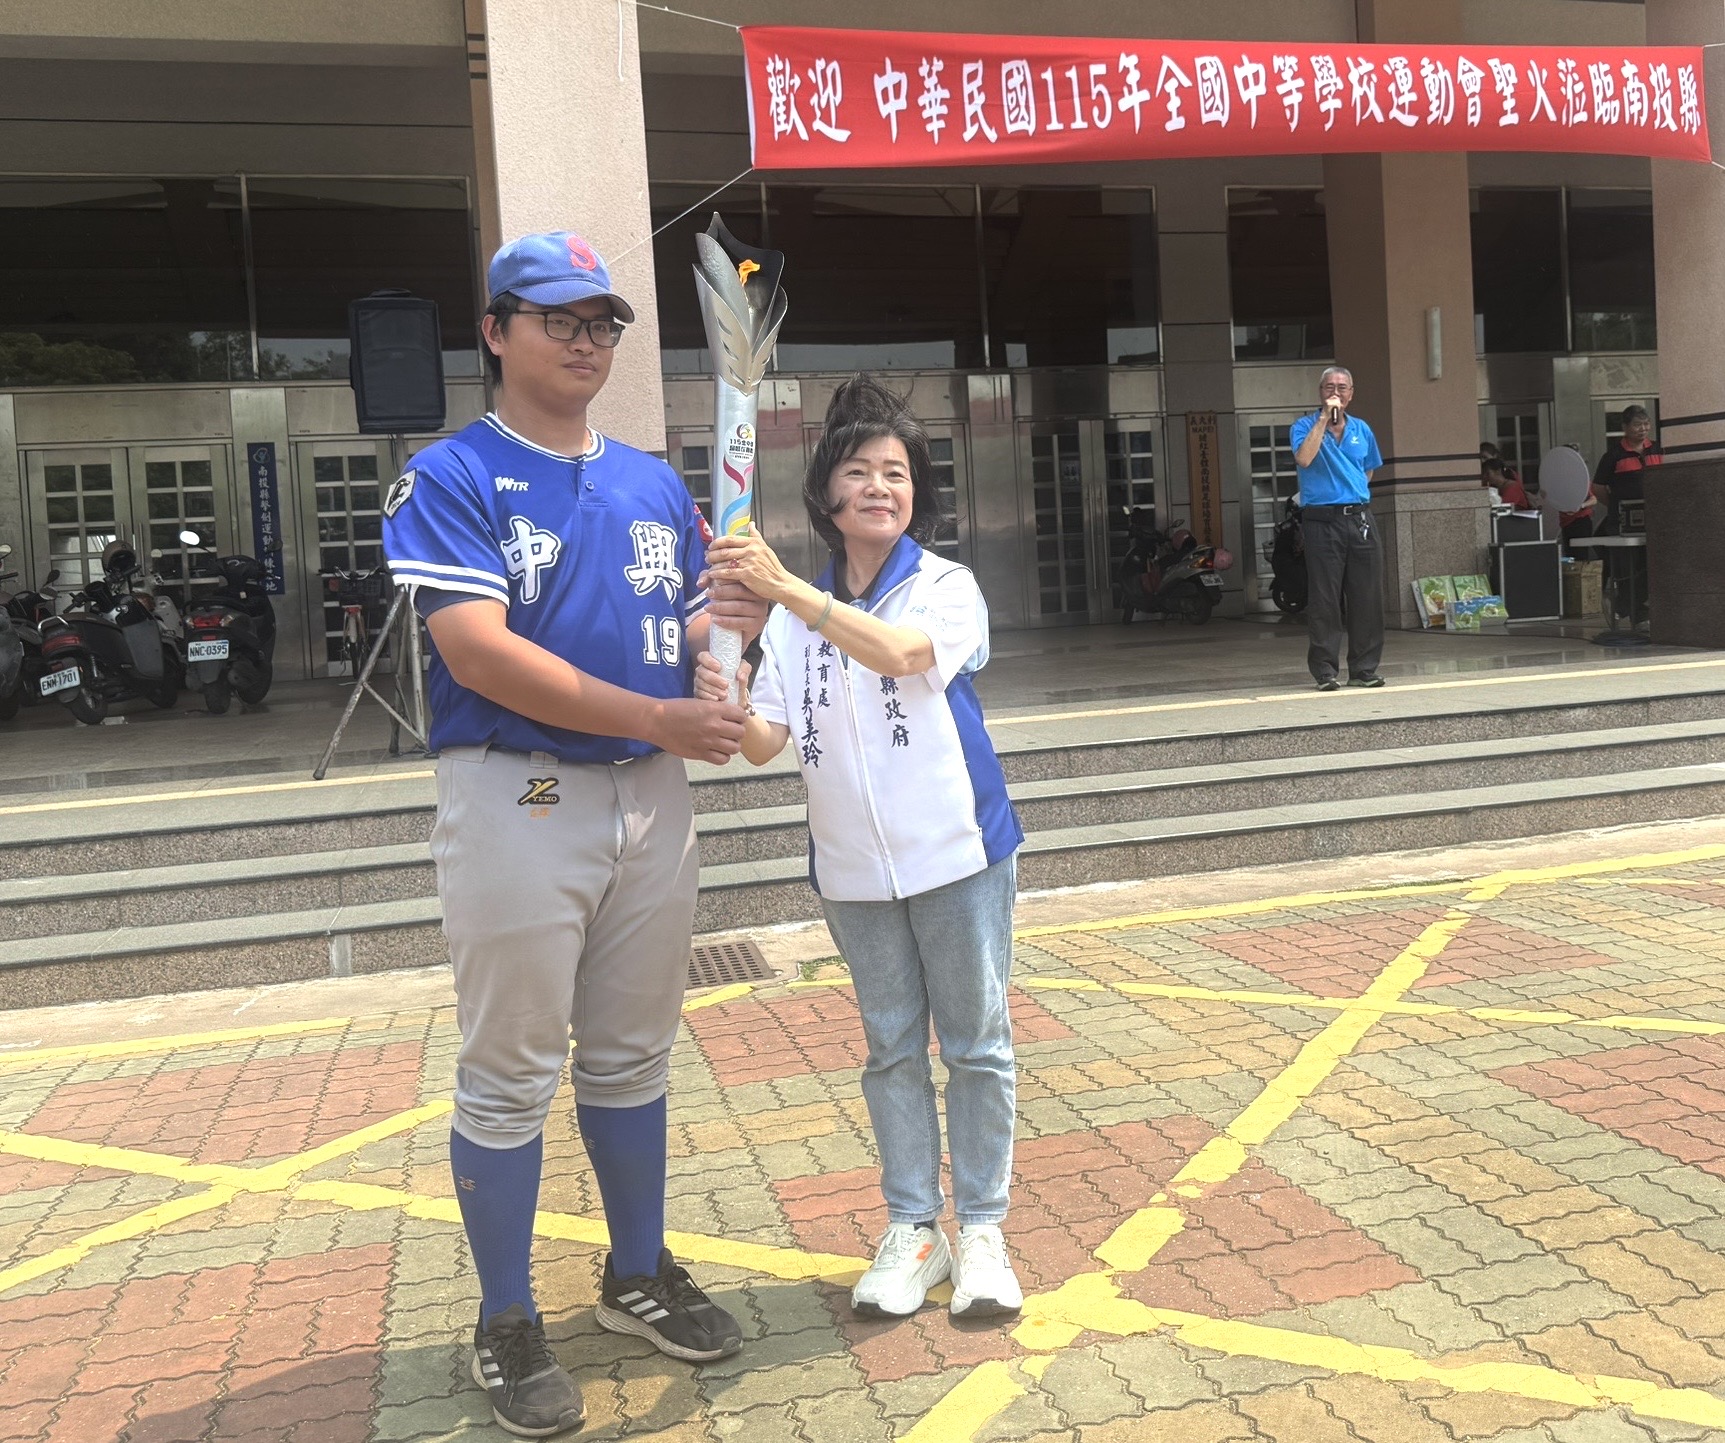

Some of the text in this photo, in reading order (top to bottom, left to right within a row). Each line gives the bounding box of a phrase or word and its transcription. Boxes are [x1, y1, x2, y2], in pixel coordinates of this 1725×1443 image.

[766, 54, 851, 142] 歡迎
[566, 235, 597, 271] S
[494, 476, 529, 492] WTR
[501, 515, 683, 604] 中 興
[189, 645, 227, 657] NNC-0395
[640, 615, 681, 666] 19
[816, 640, 833, 708] 教育處
